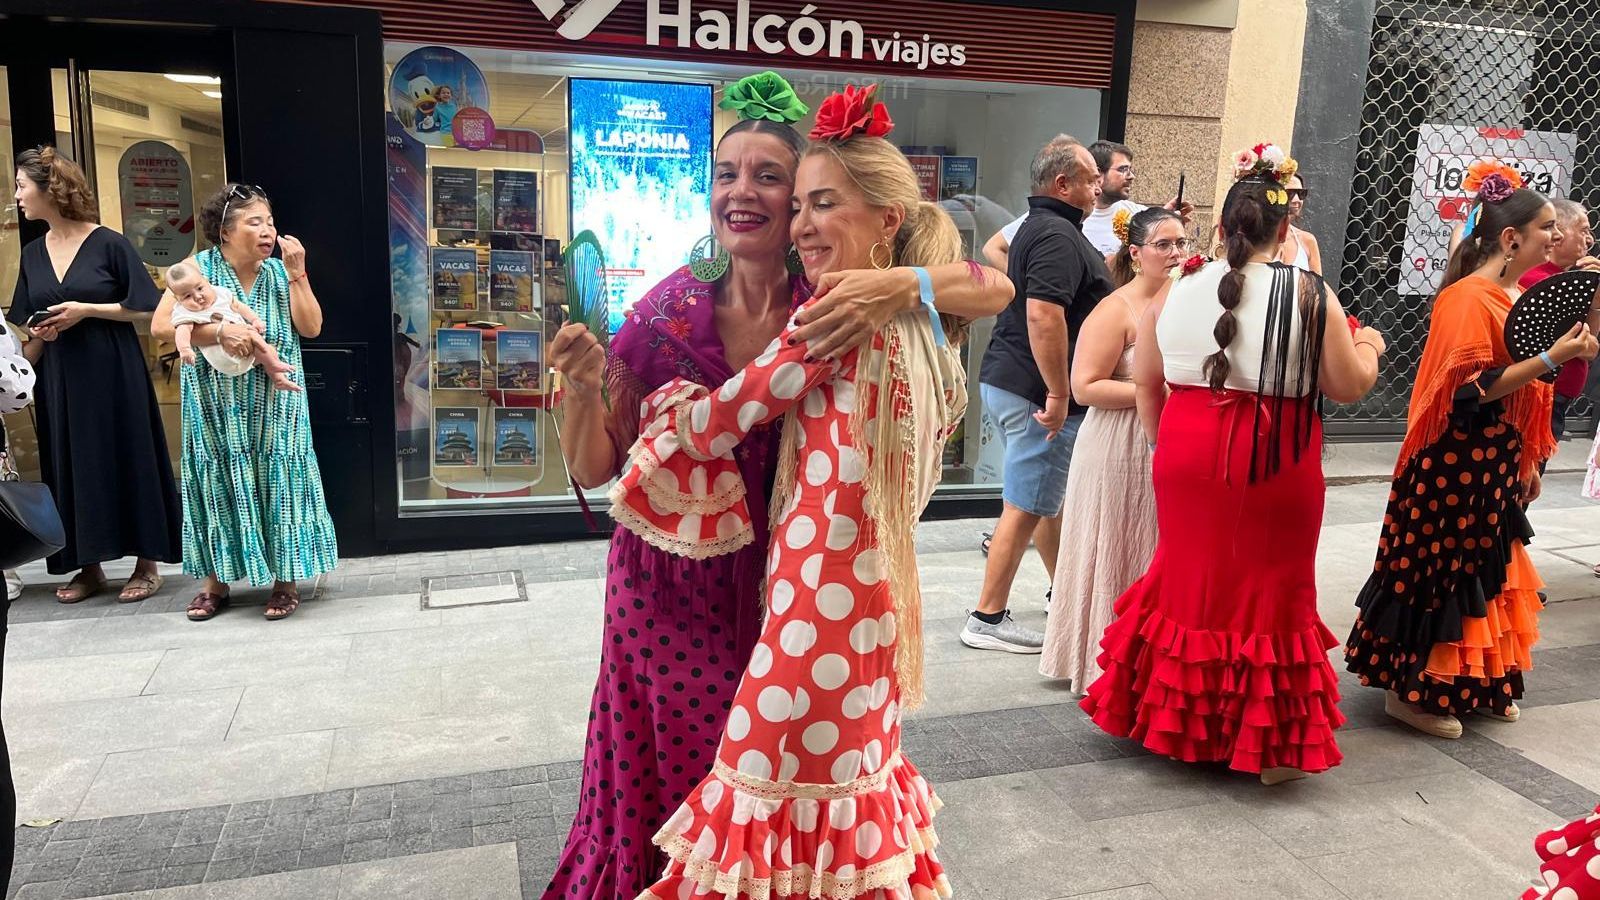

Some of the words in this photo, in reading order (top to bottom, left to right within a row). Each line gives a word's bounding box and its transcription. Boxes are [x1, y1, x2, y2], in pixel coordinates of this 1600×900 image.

[646, 0, 864, 60] Halcón
[870, 31, 967, 70] viajes
[595, 129, 690, 150] LAPONIA
[130, 158, 178, 167] ABIERTO
[440, 262, 470, 270] VACAS
[497, 264, 526, 273] VACAS
